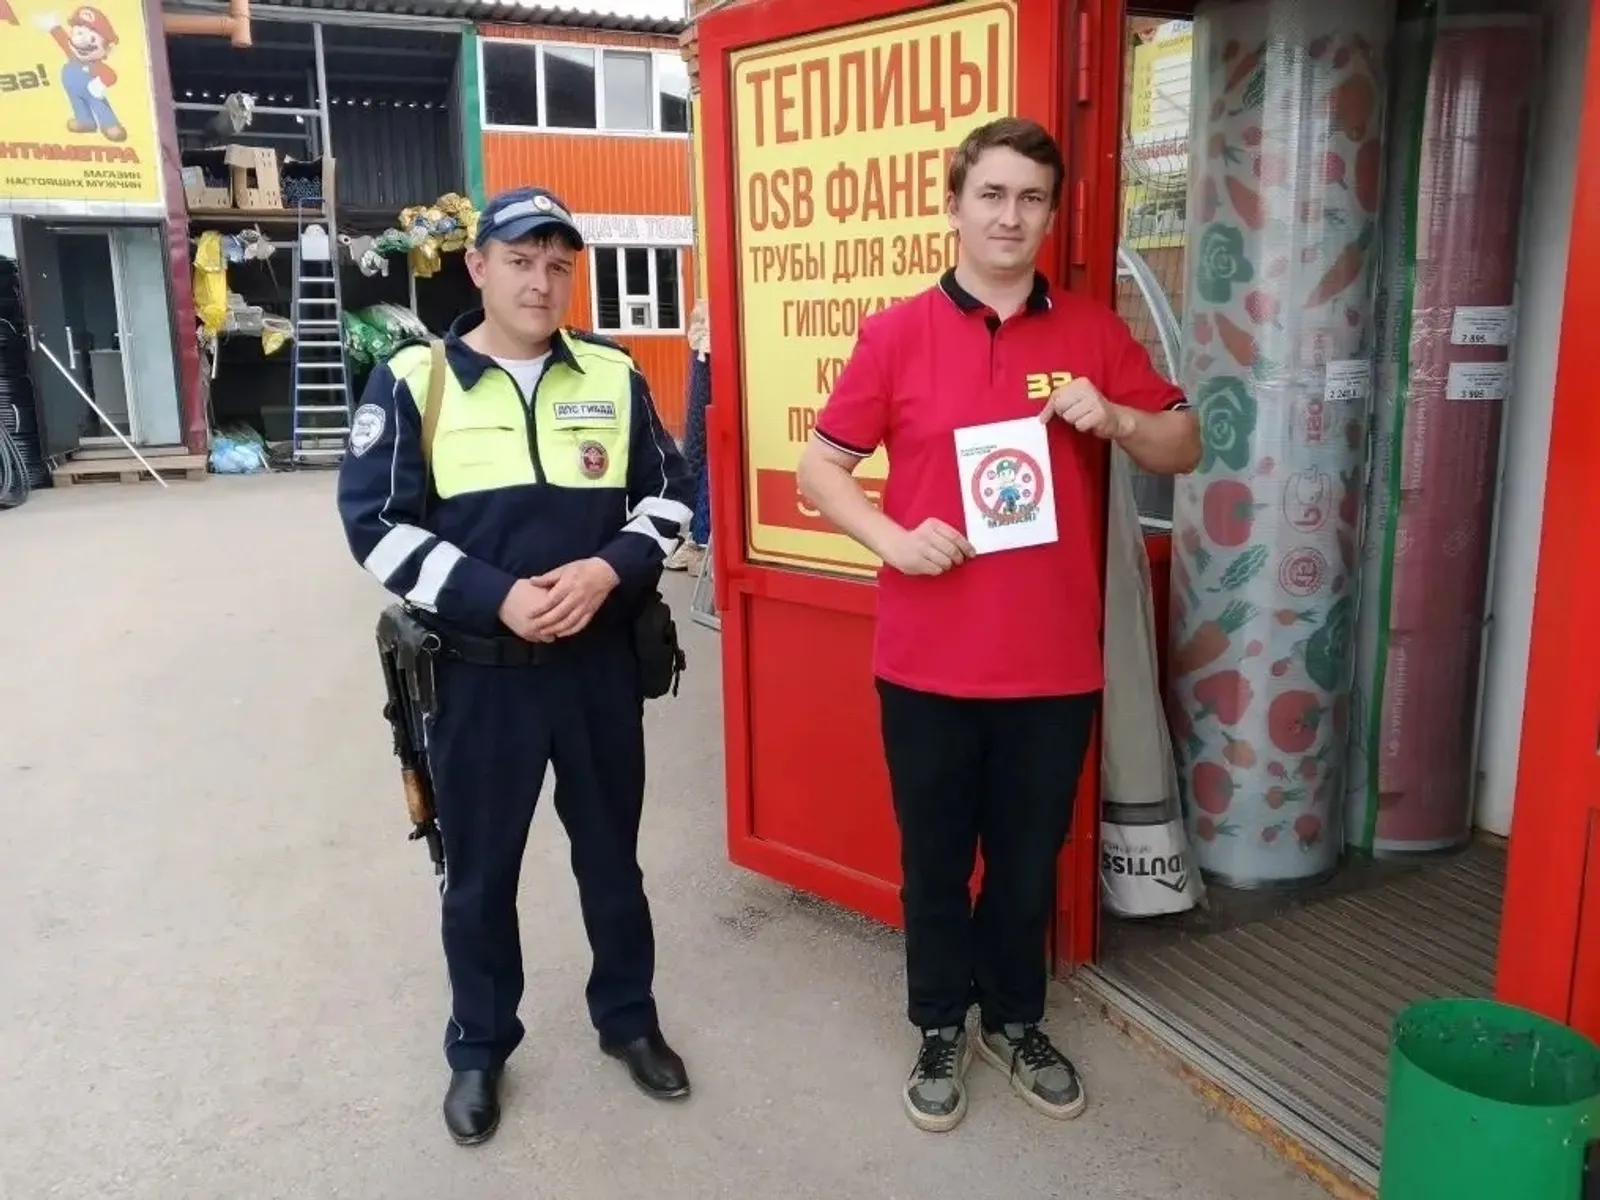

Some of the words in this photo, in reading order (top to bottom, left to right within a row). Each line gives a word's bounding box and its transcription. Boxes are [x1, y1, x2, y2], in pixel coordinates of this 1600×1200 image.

[746, 23, 999, 147] ТЕПЛИЦЫ
[5, 176, 84, 188] НАСТОЯЩИХ
[86, 179, 142, 190] МУЖЧИН
[83, 169, 142, 179] МАГАЗИН
[750, 167, 815, 231] OSB
[750, 242, 826, 283] ТРУБЫ
[832, 236, 884, 283] ДЛЯ
[783, 296, 915, 337] ГИПСОК
[817, 357, 851, 394] КР
